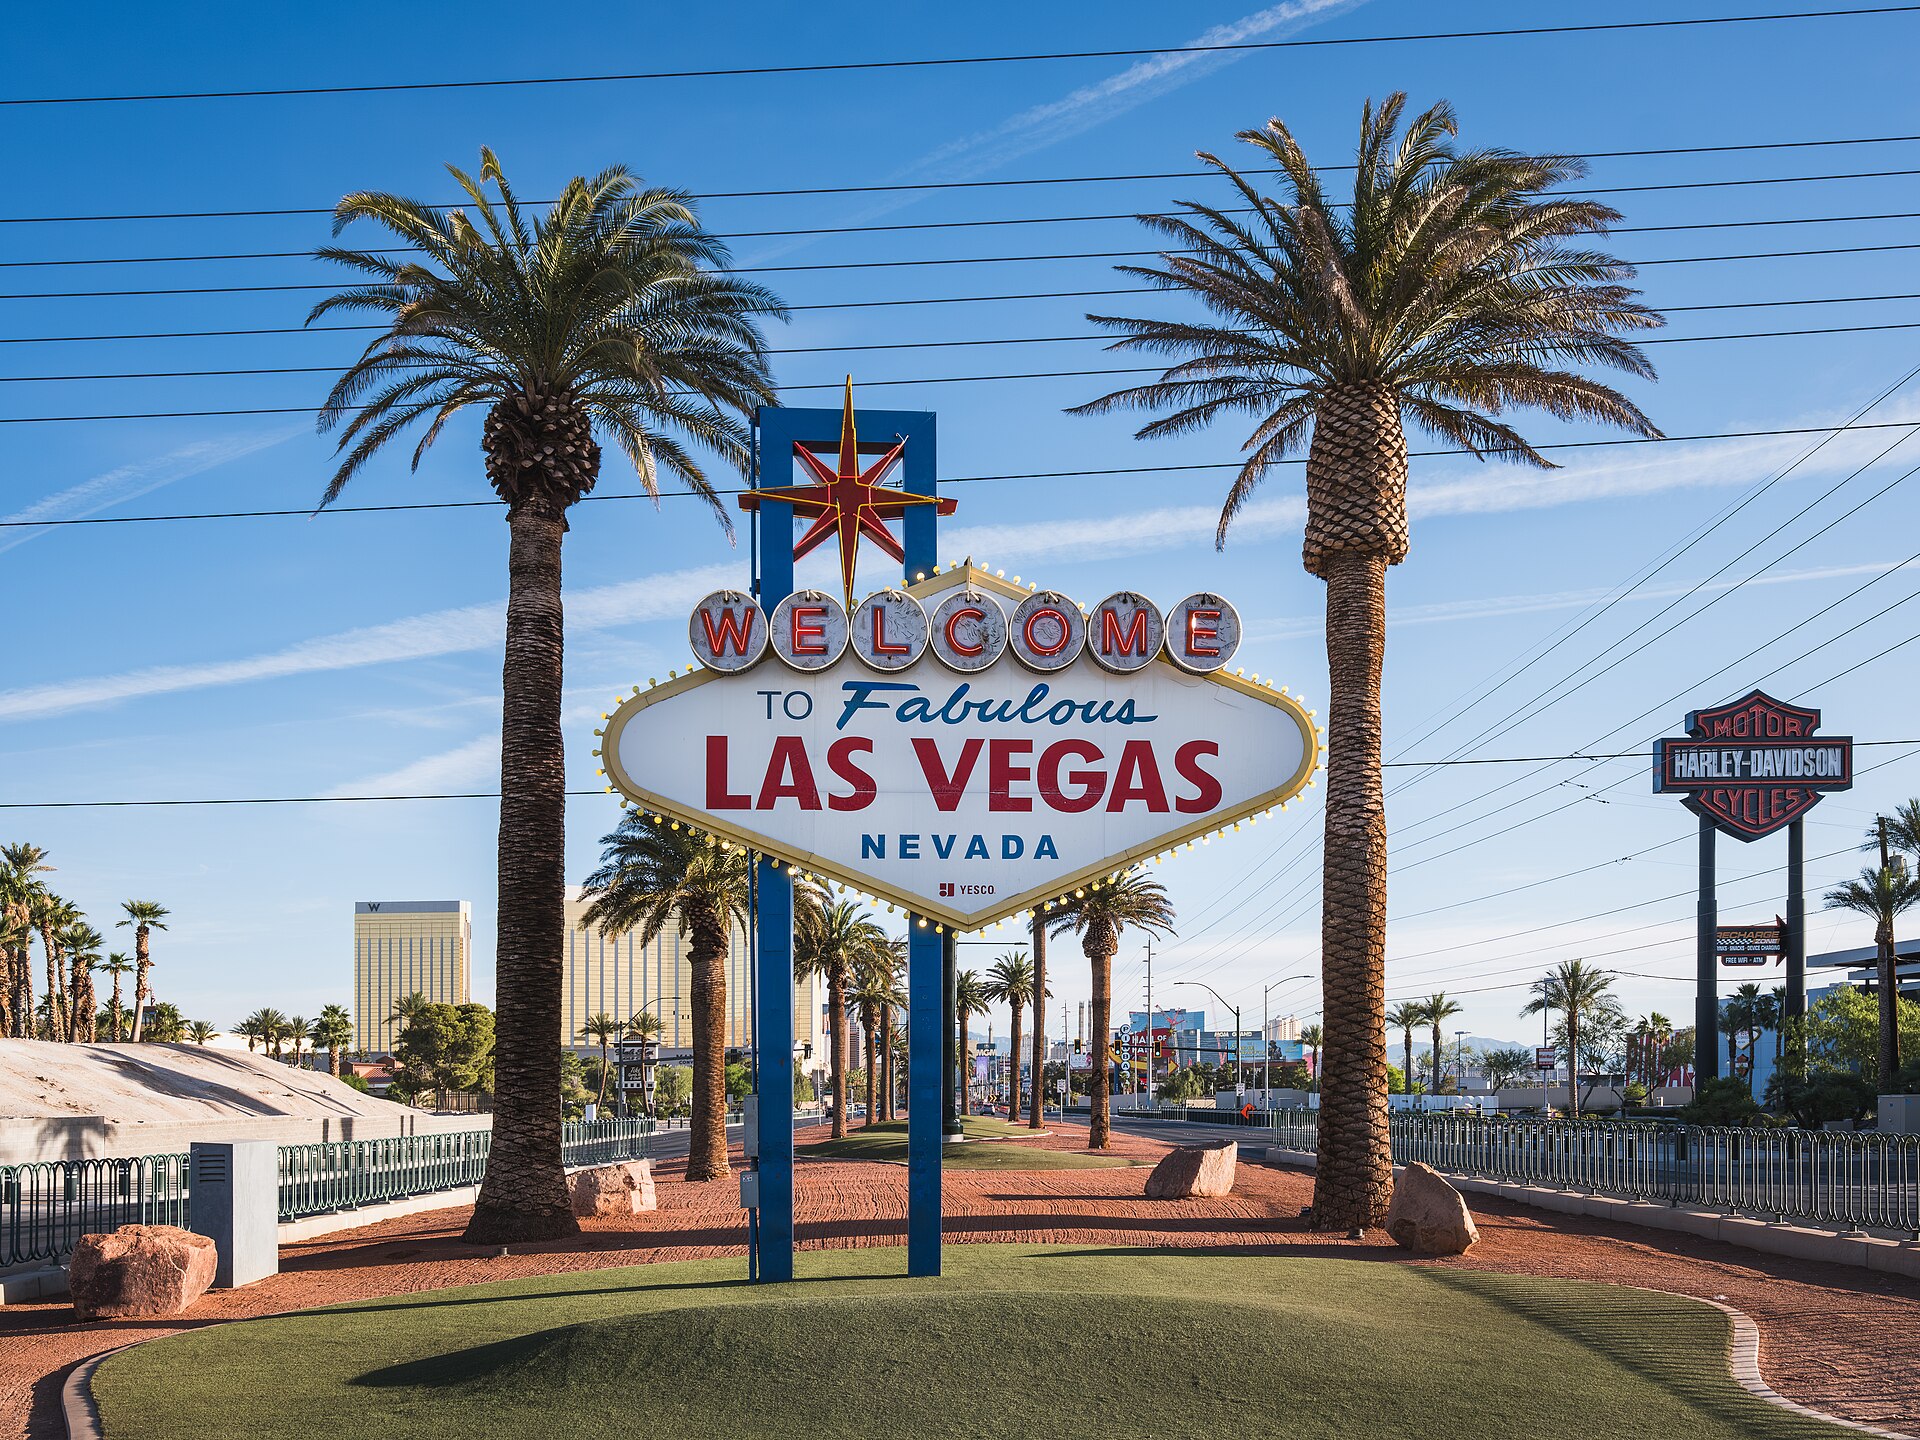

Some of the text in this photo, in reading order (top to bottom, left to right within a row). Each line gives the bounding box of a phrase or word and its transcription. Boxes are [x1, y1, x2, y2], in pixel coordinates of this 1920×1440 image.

[700, 606, 1222, 657] WELCOME
[757, 681, 1158, 730] TO Fabulous
[1713, 703, 1802, 737] MOTOR
[705, 735, 1223, 814] LAS VEGAS
[1674, 748, 1842, 778] HARLEY-DAVIDSON
[1713, 788, 1801, 825] CYCLES
[861, 834, 1059, 860] NEVADA
[367, 902, 381, 912] W
[959, 885, 995, 895] YESCO
